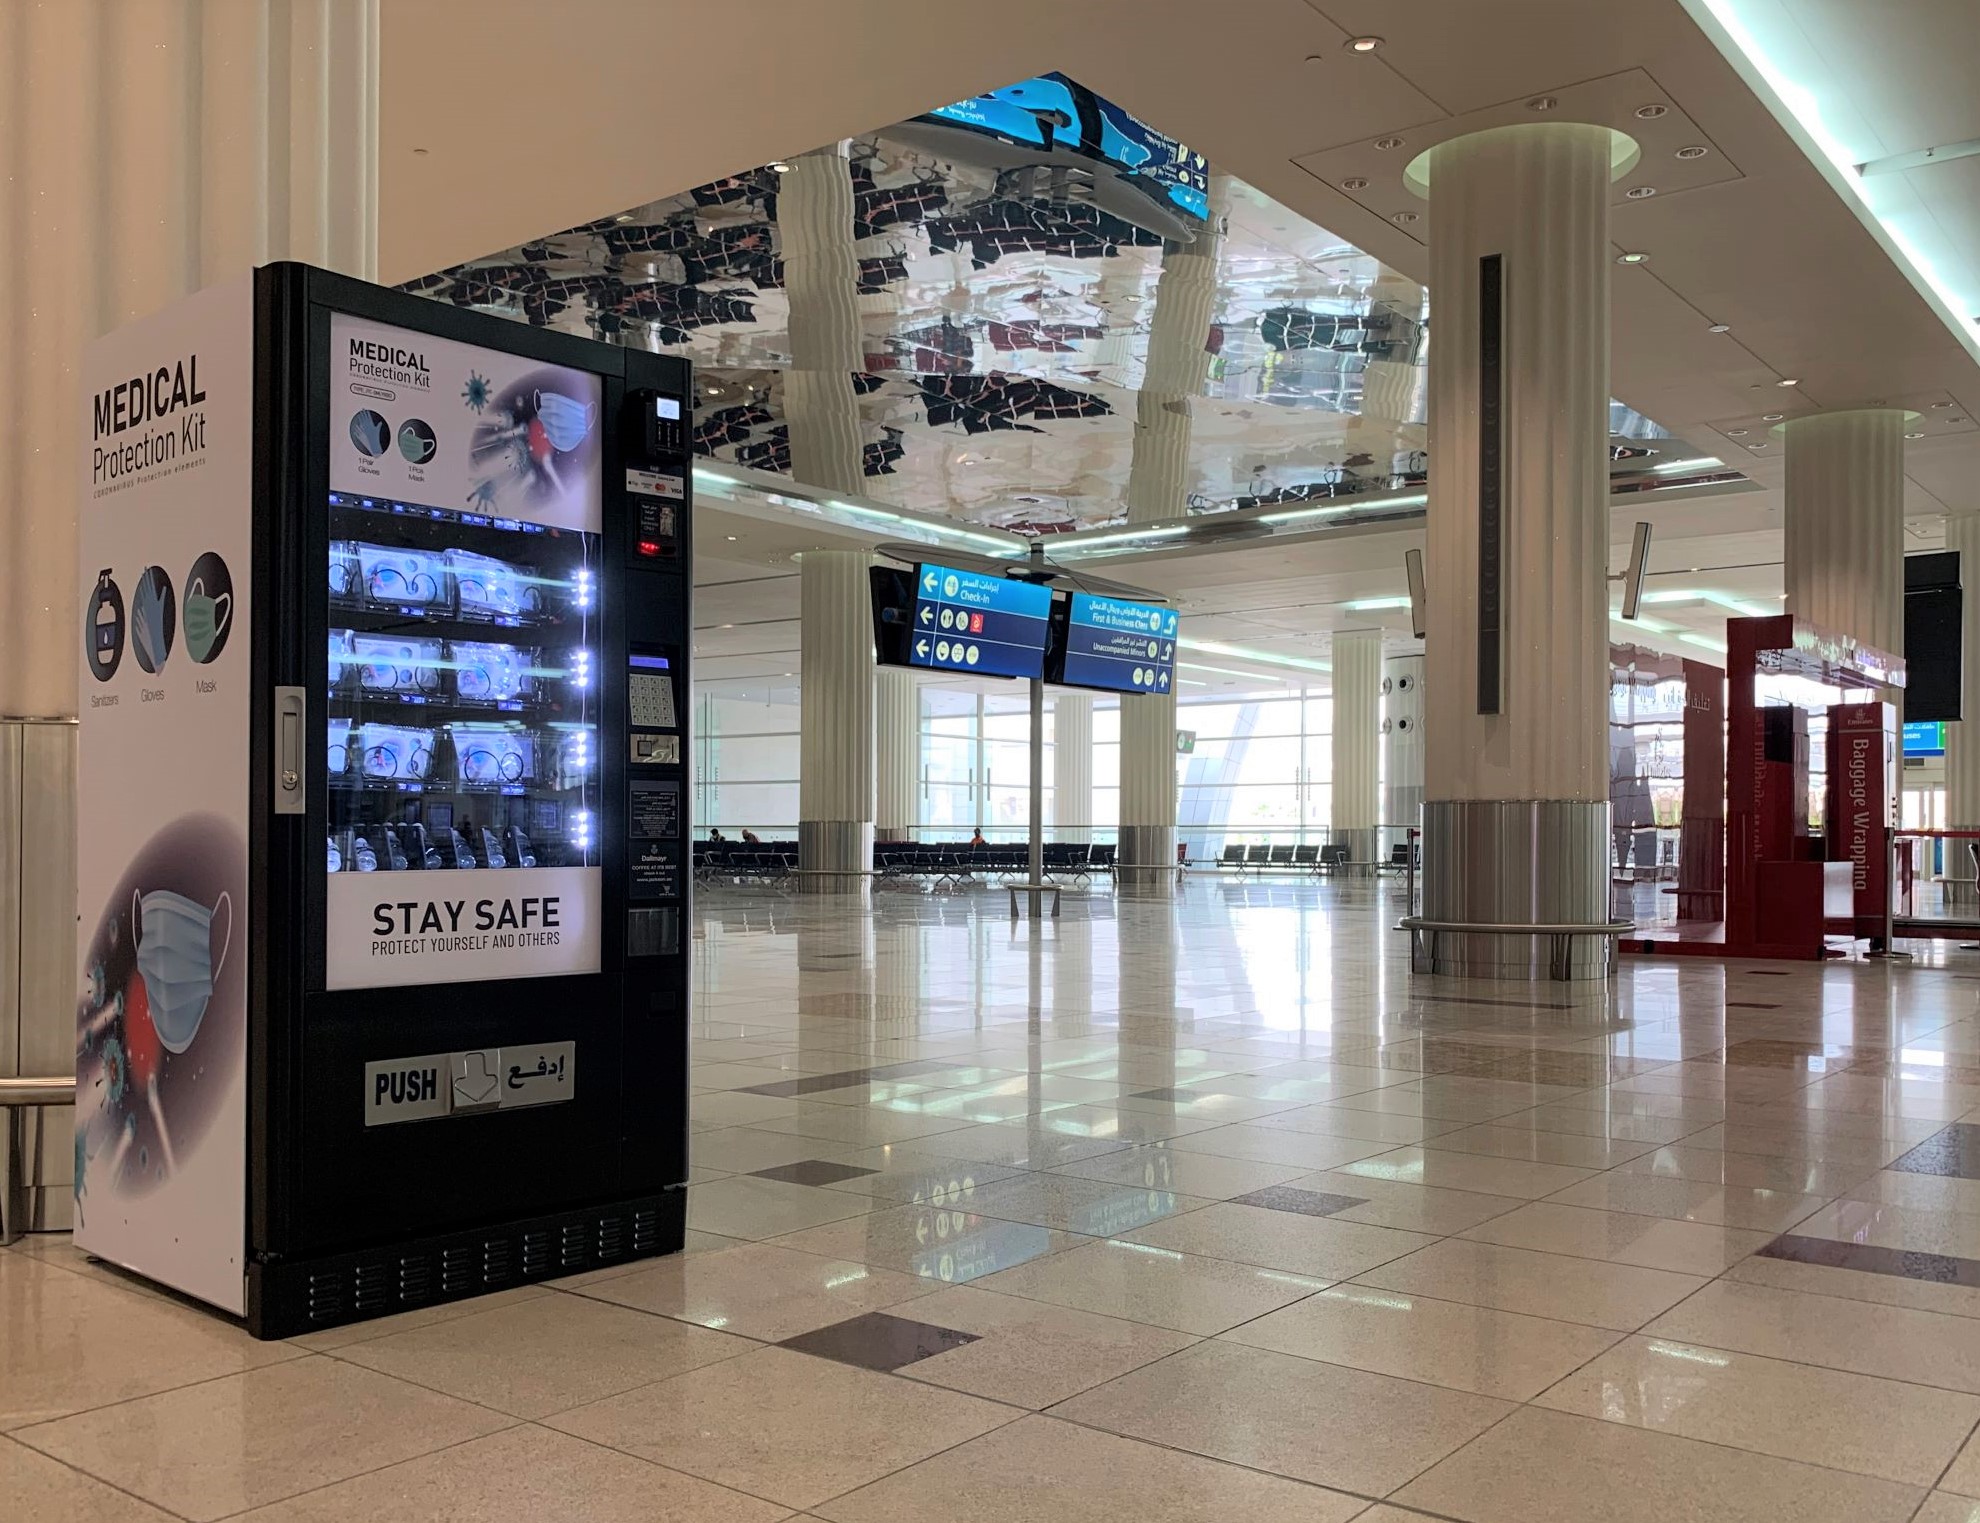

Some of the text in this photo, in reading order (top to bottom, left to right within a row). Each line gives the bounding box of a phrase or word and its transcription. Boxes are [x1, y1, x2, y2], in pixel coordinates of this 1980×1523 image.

[349, 338, 430, 373] MEDICAL
[350, 357, 411, 384] Protection
[414, 371, 430, 388] Kit
[94, 354, 206, 441] MEDICAL
[93, 412, 206, 484] Protection Kit
[358, 465, 380, 476] Gloves
[408, 473, 425, 482] Mask
[960, 589, 990, 604] Check-In
[1092, 612, 1105, 623] First
[1111, 616, 1135, 628] Business
[1093, 642, 1146, 657] Unaccompanied Minors
[141, 688, 165, 702] Gloves
[196, 680, 217, 693] Mask
[1849, 738, 1869, 807] Baggage
[641, 855, 667, 863] Dallmayr
[373, 897, 560, 936] STAY SAFE
[372, 931, 560, 956] PROTECT YOURSELF AND OTHERS
[507, 1055, 565, 1089] إدفع
[375, 1068, 437, 1106] PUSH
